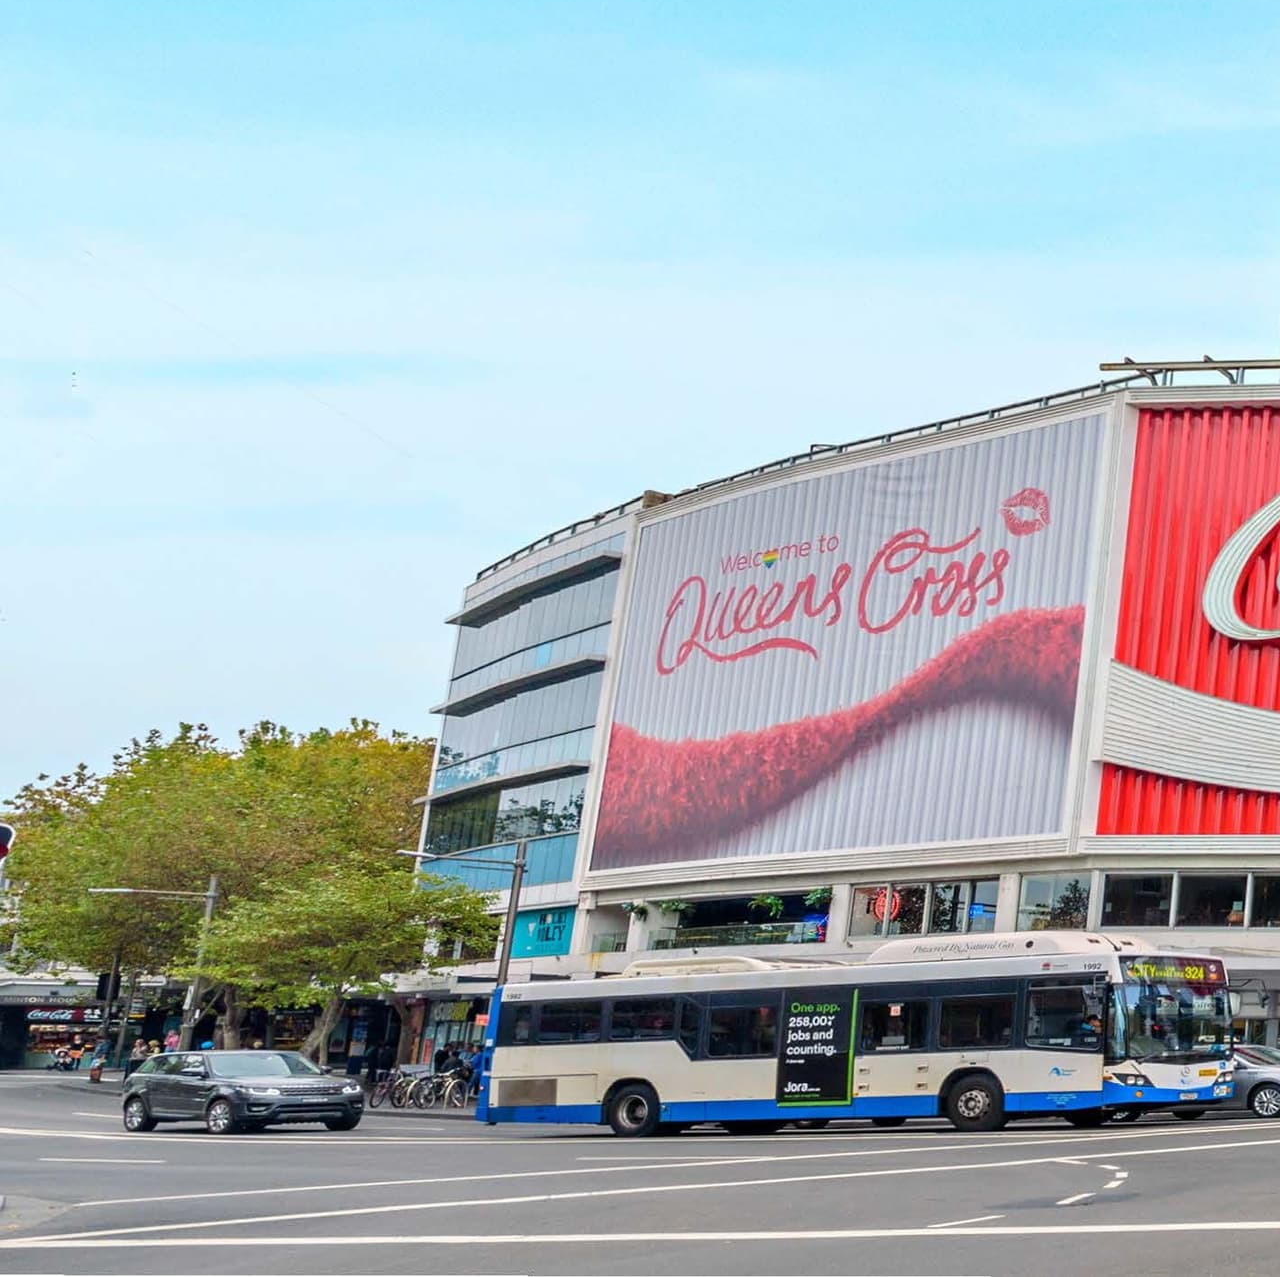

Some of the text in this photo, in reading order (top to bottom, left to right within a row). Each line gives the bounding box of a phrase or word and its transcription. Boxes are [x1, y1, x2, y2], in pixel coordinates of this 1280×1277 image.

[818, 533, 840, 555] to
[656, 526, 1010, 675] Queens Cross
[1083, 962, 1102, 970] 1992
[1134, 963, 1156, 978] CITY
[1184, 966, 1204, 979] 324
[790, 1002, 841, 1014] One app.
[786, 1028, 833, 1043] jobs and
[786, 1042, 837, 1056] counting.
[784, 1082, 808, 1093] Jora
